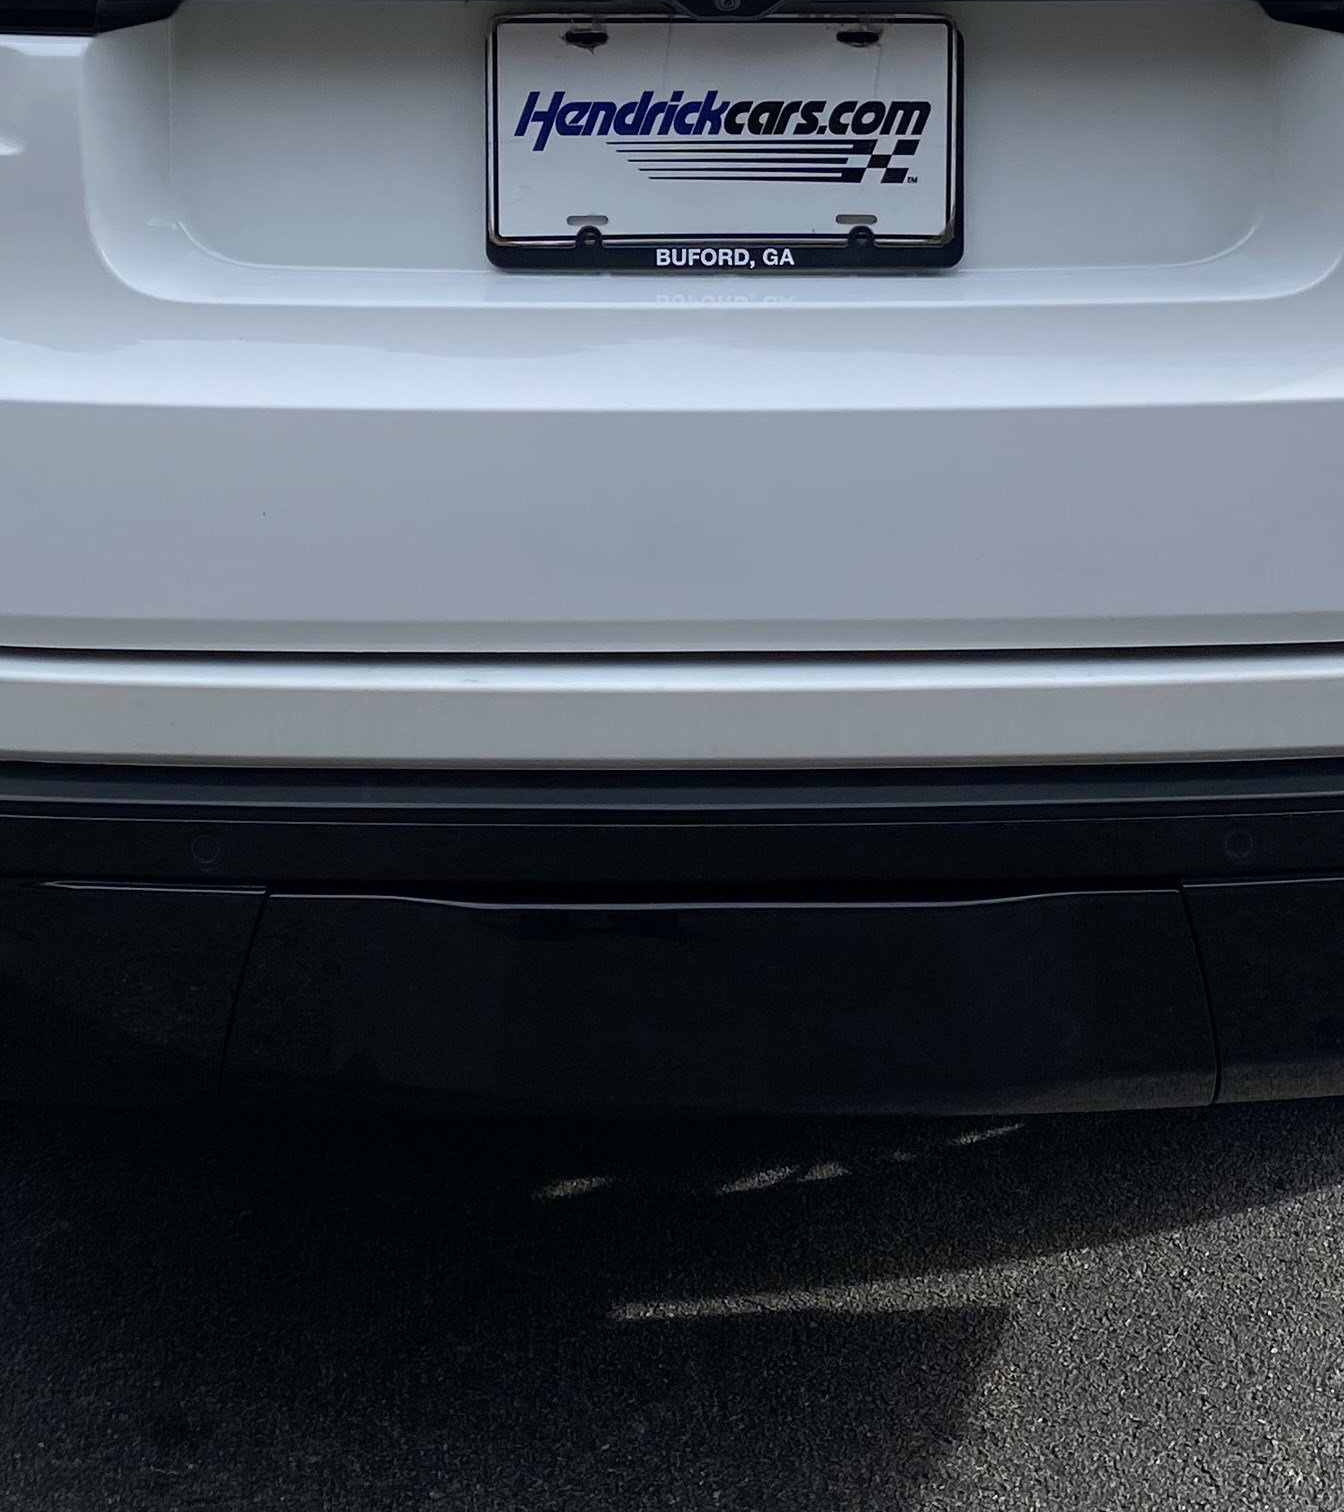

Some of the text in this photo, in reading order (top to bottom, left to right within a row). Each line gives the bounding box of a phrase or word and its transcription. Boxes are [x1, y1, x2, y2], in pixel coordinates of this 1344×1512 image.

[513, 89, 932, 152] Hendrickcars.com
[655, 247, 796, 269] BUFORD, GA
